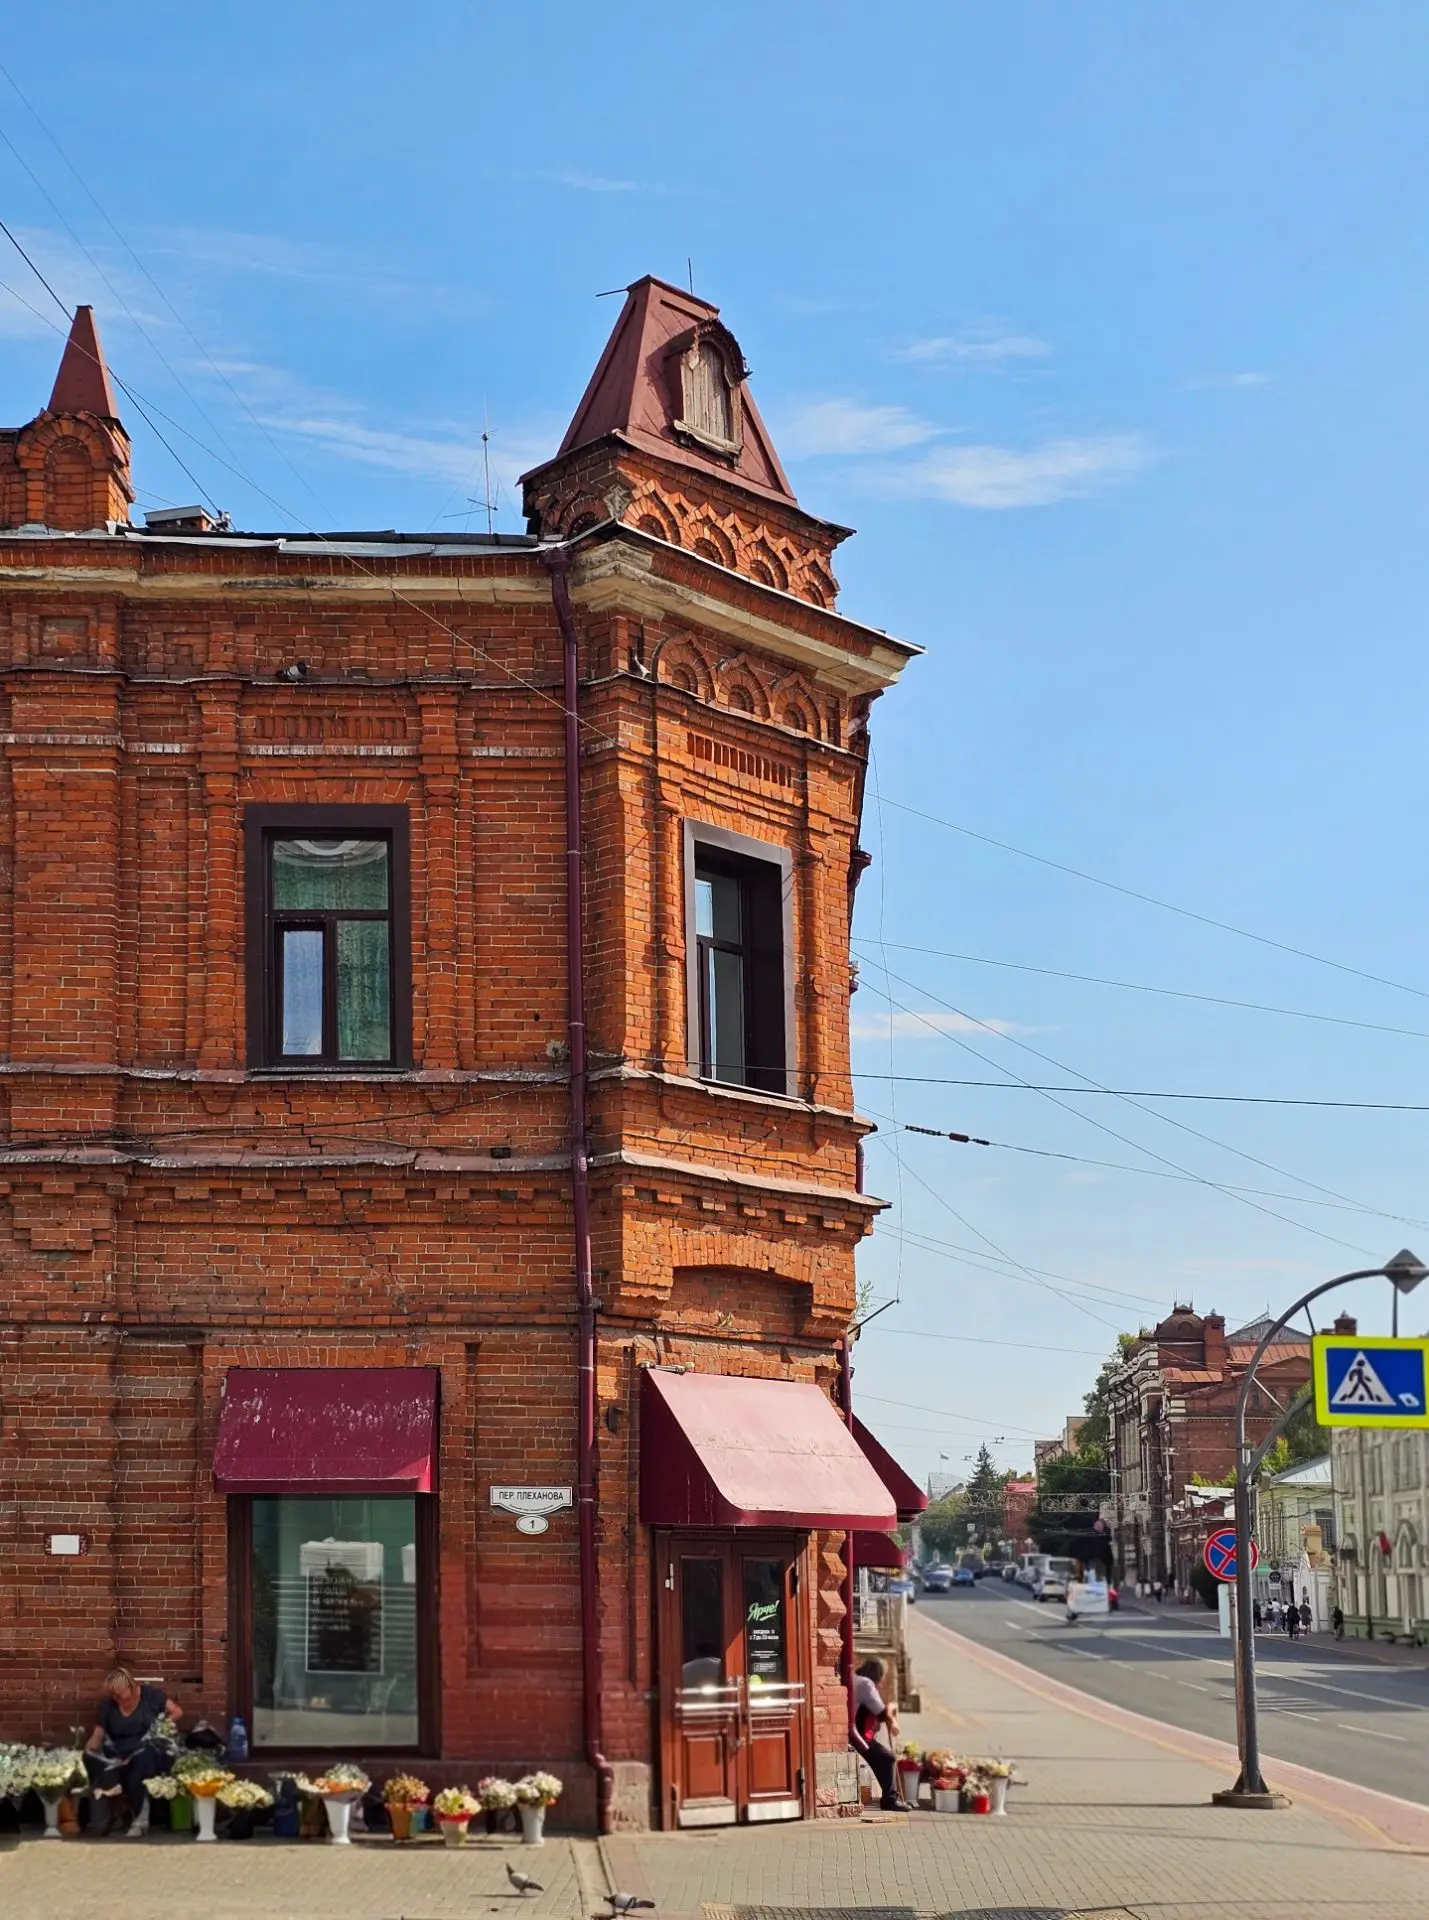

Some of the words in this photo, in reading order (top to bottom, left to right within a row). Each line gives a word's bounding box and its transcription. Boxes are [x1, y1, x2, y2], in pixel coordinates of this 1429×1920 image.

[516, 1491, 564, 1501] ПЛЕХАНОВА
[529, 1520, 535, 1529] 1
[747, 1600, 780, 1621] Ярче!
